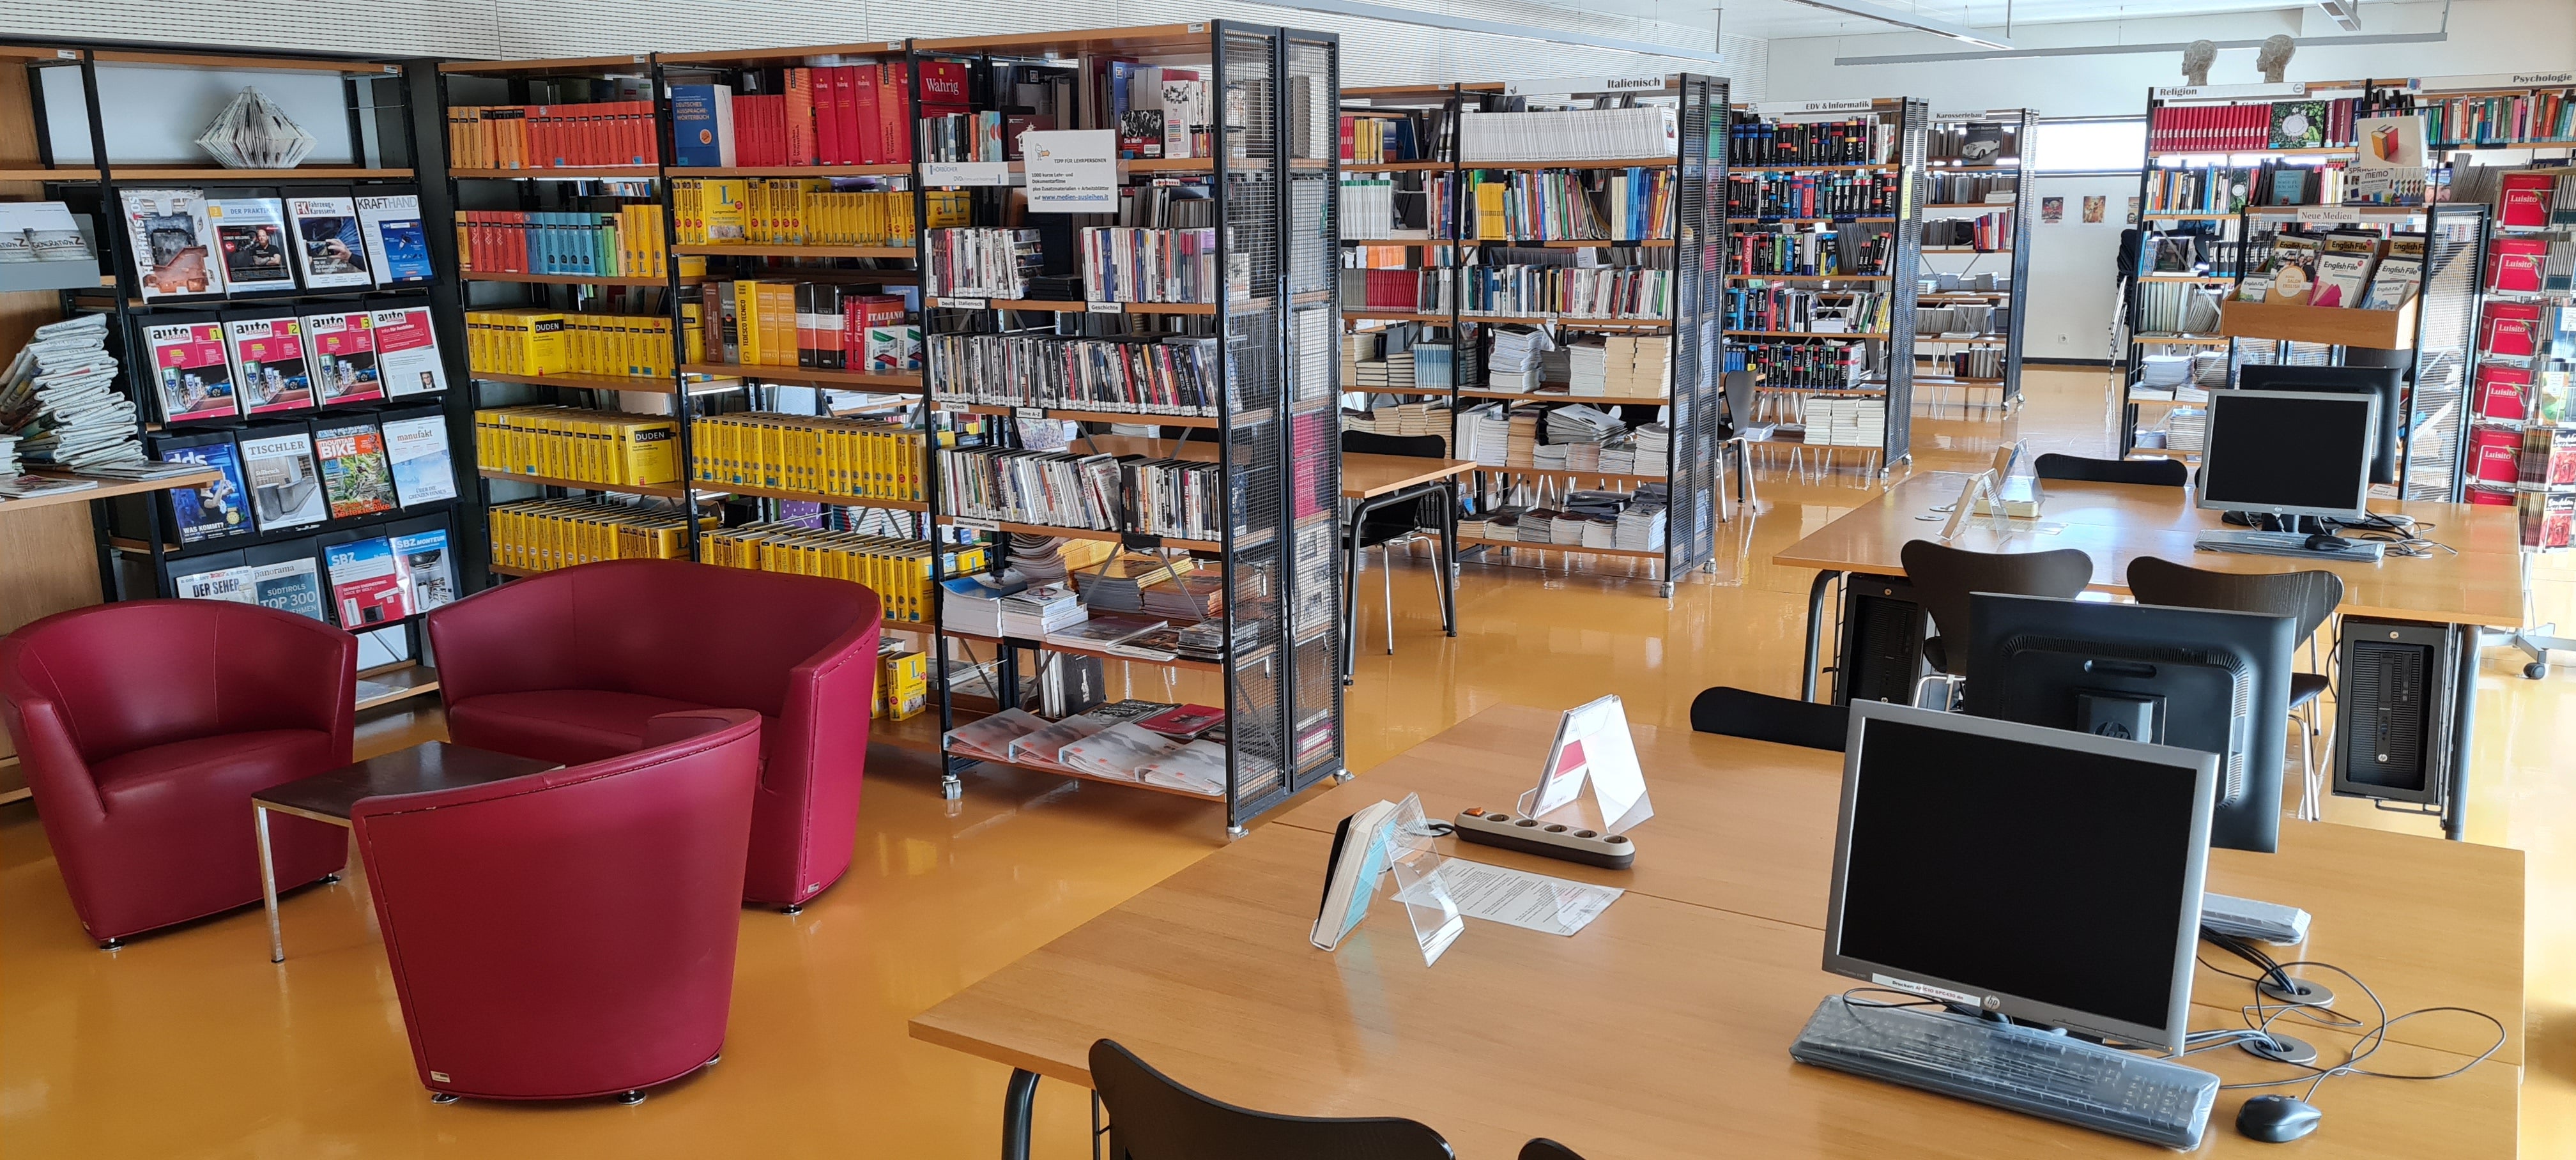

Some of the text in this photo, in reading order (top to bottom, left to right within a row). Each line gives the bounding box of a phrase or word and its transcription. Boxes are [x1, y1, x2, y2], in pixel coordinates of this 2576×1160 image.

[1607, 77, 1661, 89] Italienisch
[2513, 73, 2572, 83] Psychologie
[926, 77, 959, 95] Wahrig
[2159, 88, 2197, 96] Religion
[1828, 100, 1869, 109] Informatik
[2365, 171, 2388, 179] MEMO
[719, 185, 733, 204] L
[2510, 195, 2538, 203] Luisito
[295, 201, 309, 215] FK
[358, 197, 417, 210] KRAFTHAND
[2301, 210, 2352, 220] Neue Medien
[128, 195, 154, 275] HEPHAISTOS
[32, 236, 85, 248] GENERATION Z
[2332, 241, 2367, 252] English File
[2394, 242, 2416, 252] English
[2324, 262, 2347, 271] English
[2506, 259, 2533, 268] Luisito
[2382, 265, 2405, 274] English
[378, 311, 403, 321] auto
[868, 311, 904, 322] ITALIANO
[312, 316, 370, 328] auto 3
[535, 323, 559, 332] DUDEN
[2499, 323, 2526, 332] Luisito
[153, 327, 220, 339] auto 1
[236, 322, 298, 334] auto 2
[2490, 387, 2517, 396] Luisito
[397, 430, 433, 442] manufakt
[636, 431, 664, 441] DUDEN
[249, 441, 305, 455] TISCHLER
[321, 443, 357, 459] BIKE
[2485, 450, 2511, 460] Luisito
[372, 502, 390, 512] Bike
[199, 521, 224, 531] KOMMT?
[956, 520, 995, 529] Dokumentarfilme
[397, 536, 445, 549] SBZ MONTEUR
[331, 552, 355, 565] SBZ
[254, 565, 295, 580] panorama
[192, 583, 211, 597] DER
[267, 583, 306, 597] SÜDTIROLS
[260, 591, 316, 609] TOP 300
[910, 660, 919, 679] L
[1892, 981, 1914, 989] Drucken
[1985, 995, 1998, 1009] hp
